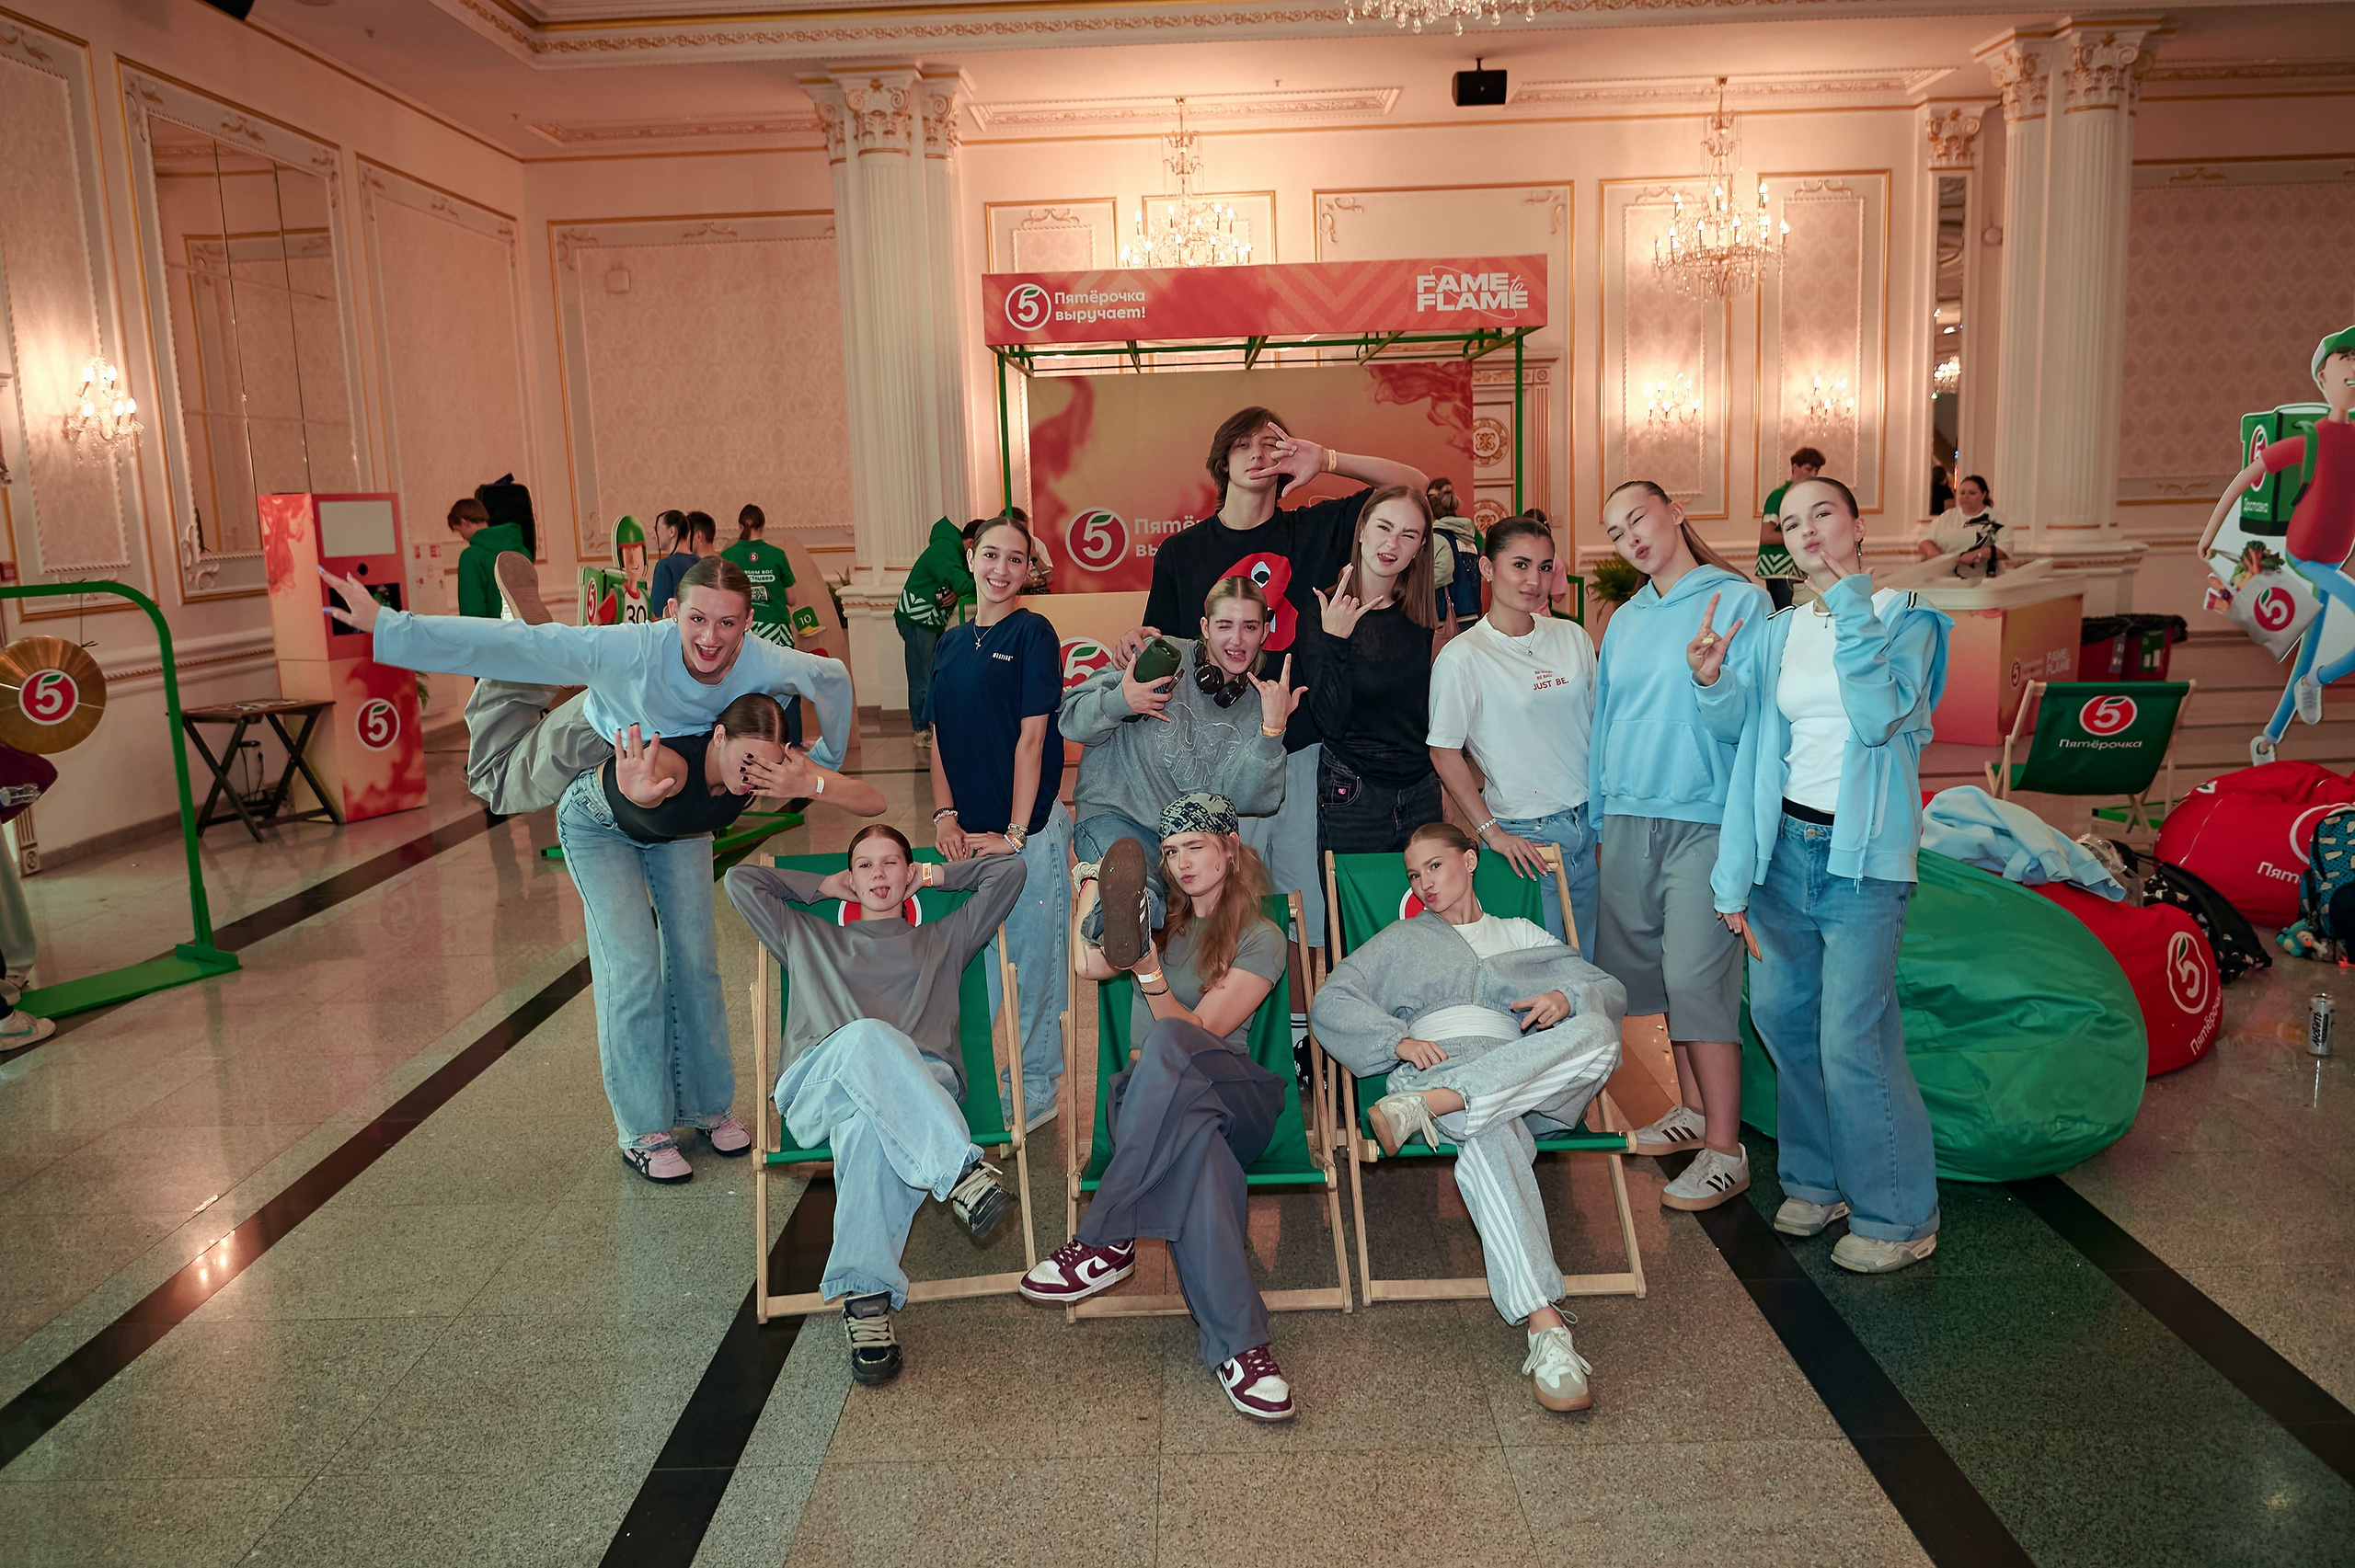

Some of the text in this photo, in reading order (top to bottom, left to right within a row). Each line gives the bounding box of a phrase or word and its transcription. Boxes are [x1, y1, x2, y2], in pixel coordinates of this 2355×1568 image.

[1417, 272, 1509, 293] FAME
[1054, 290, 1145, 305] Пятёрочка
[1417, 291, 1529, 312] FLAME
[1055, 306, 1145, 323] выручает!
[1134, 515, 1205, 534] Пятё
[799, 614, 811, 625] 10
[1534, 677, 1569, 691] JUST BE.
[2059, 738, 2142, 750] Пятёрочка
[2257, 862, 2302, 885] Пят
